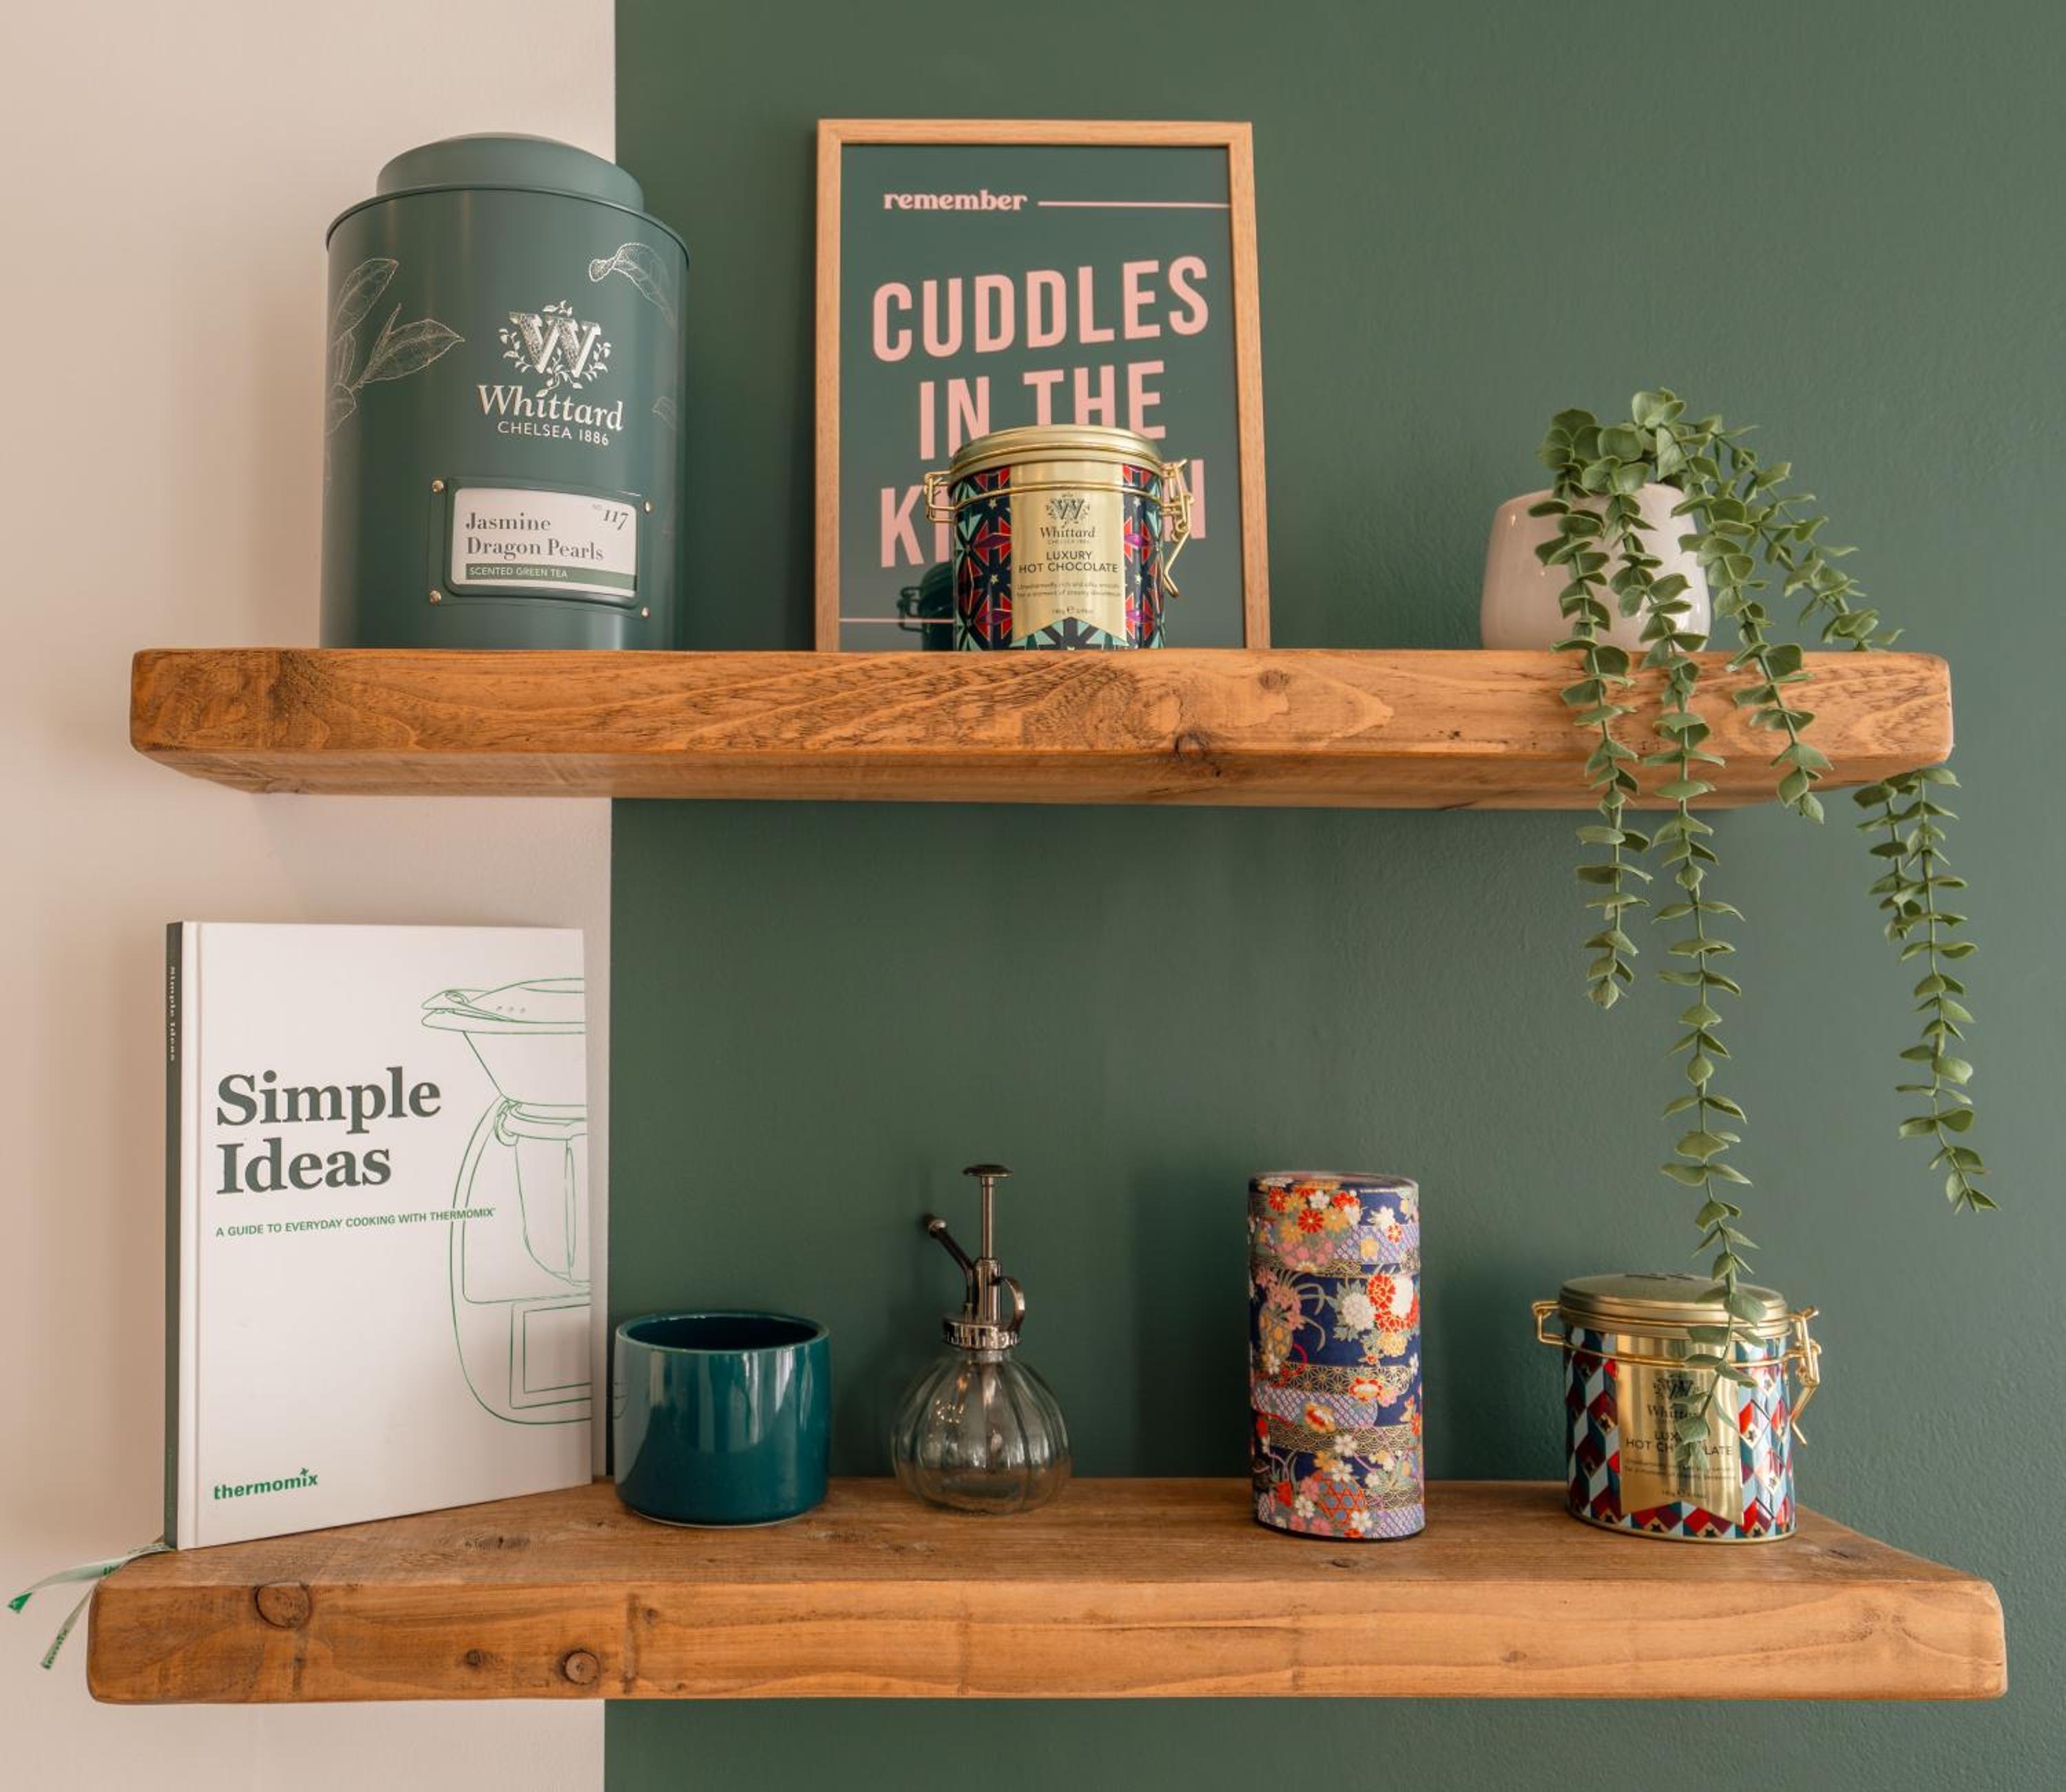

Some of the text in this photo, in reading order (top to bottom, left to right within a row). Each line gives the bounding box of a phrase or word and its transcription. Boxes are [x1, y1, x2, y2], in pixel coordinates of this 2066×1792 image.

[883, 189, 1027, 211] remember
[872, 256, 1209, 362] CUDDLES
[477, 385, 623, 431] Whittard
[919, 360, 1166, 460] IN THE
[497, 421, 609, 446] CHELSEA 1886
[465, 512, 551, 531] Jasmine
[603, 509, 629, 531] 117
[1039, 526, 1096, 539] Whittard
[466, 536, 604, 561] Dragon Pearls
[1046, 550, 1093, 561] LUXURY
[469, 566, 568, 579] SCENTED GREEN TEA
[1019, 561, 1118, 574] HOT CHOCOLATE
[216, 1065, 441, 1134] Simple
[216, 1136, 391, 1194] Ideas
[216, 1227, 225, 1237] A
[228, 1224, 264, 1236] GUIDE
[267, 1222, 282, 1233] TO
[285, 1218, 342, 1232] EVERYDAY
[346, 1215, 395, 1228] COOKING
[398, 1212, 426, 1223] WITH
[1626, 1437, 1734, 1456] HOT CHLATE
[213, 1468, 318, 1500] thermomix
